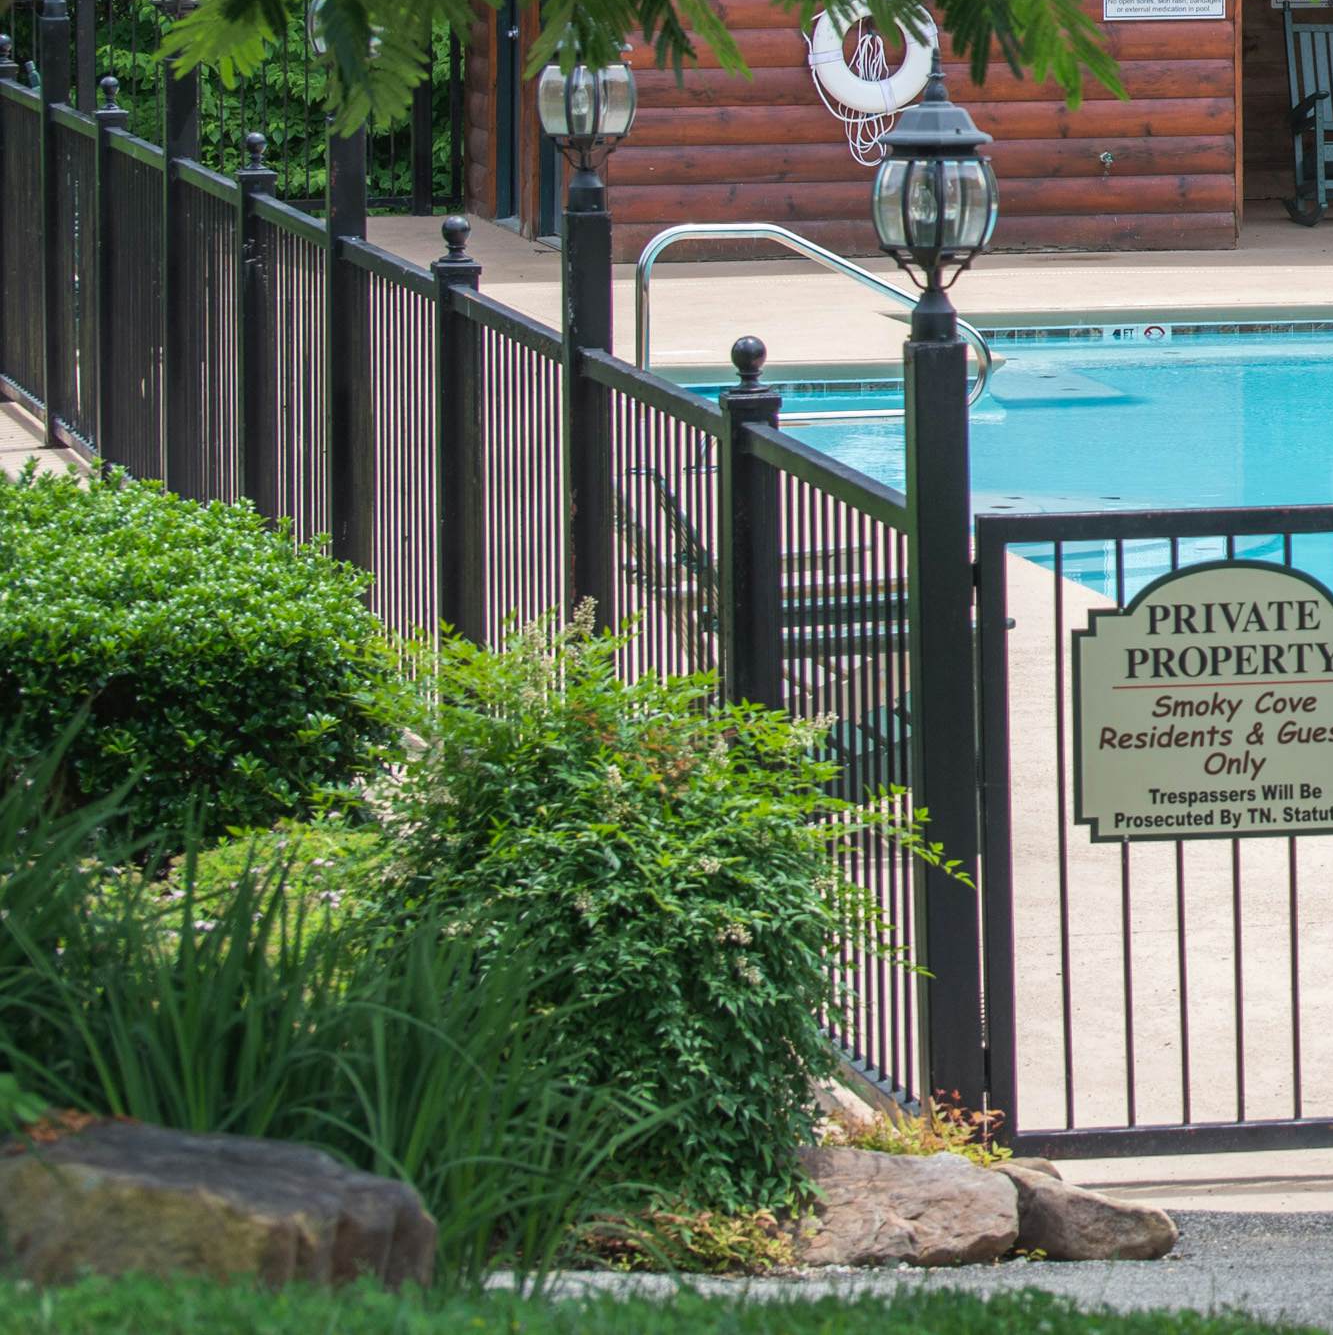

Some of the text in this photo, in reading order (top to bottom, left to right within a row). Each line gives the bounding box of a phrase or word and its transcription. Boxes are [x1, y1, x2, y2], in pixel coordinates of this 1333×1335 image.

[1146, 600, 1321, 635] PRIVATE
[1152, 691, 1317, 723] Smoky Cove
[1099, 724, 1233, 750] Residents
[1246, 722, 1265, 746] &
[1203, 750, 1267, 781] Only
[1149, 783, 1322, 807] Trespassers Will Be
[1114, 809, 1214, 829] Prosecuted
[1219, 809, 1242, 829] By
[1247, 807, 1278, 825] TN.
